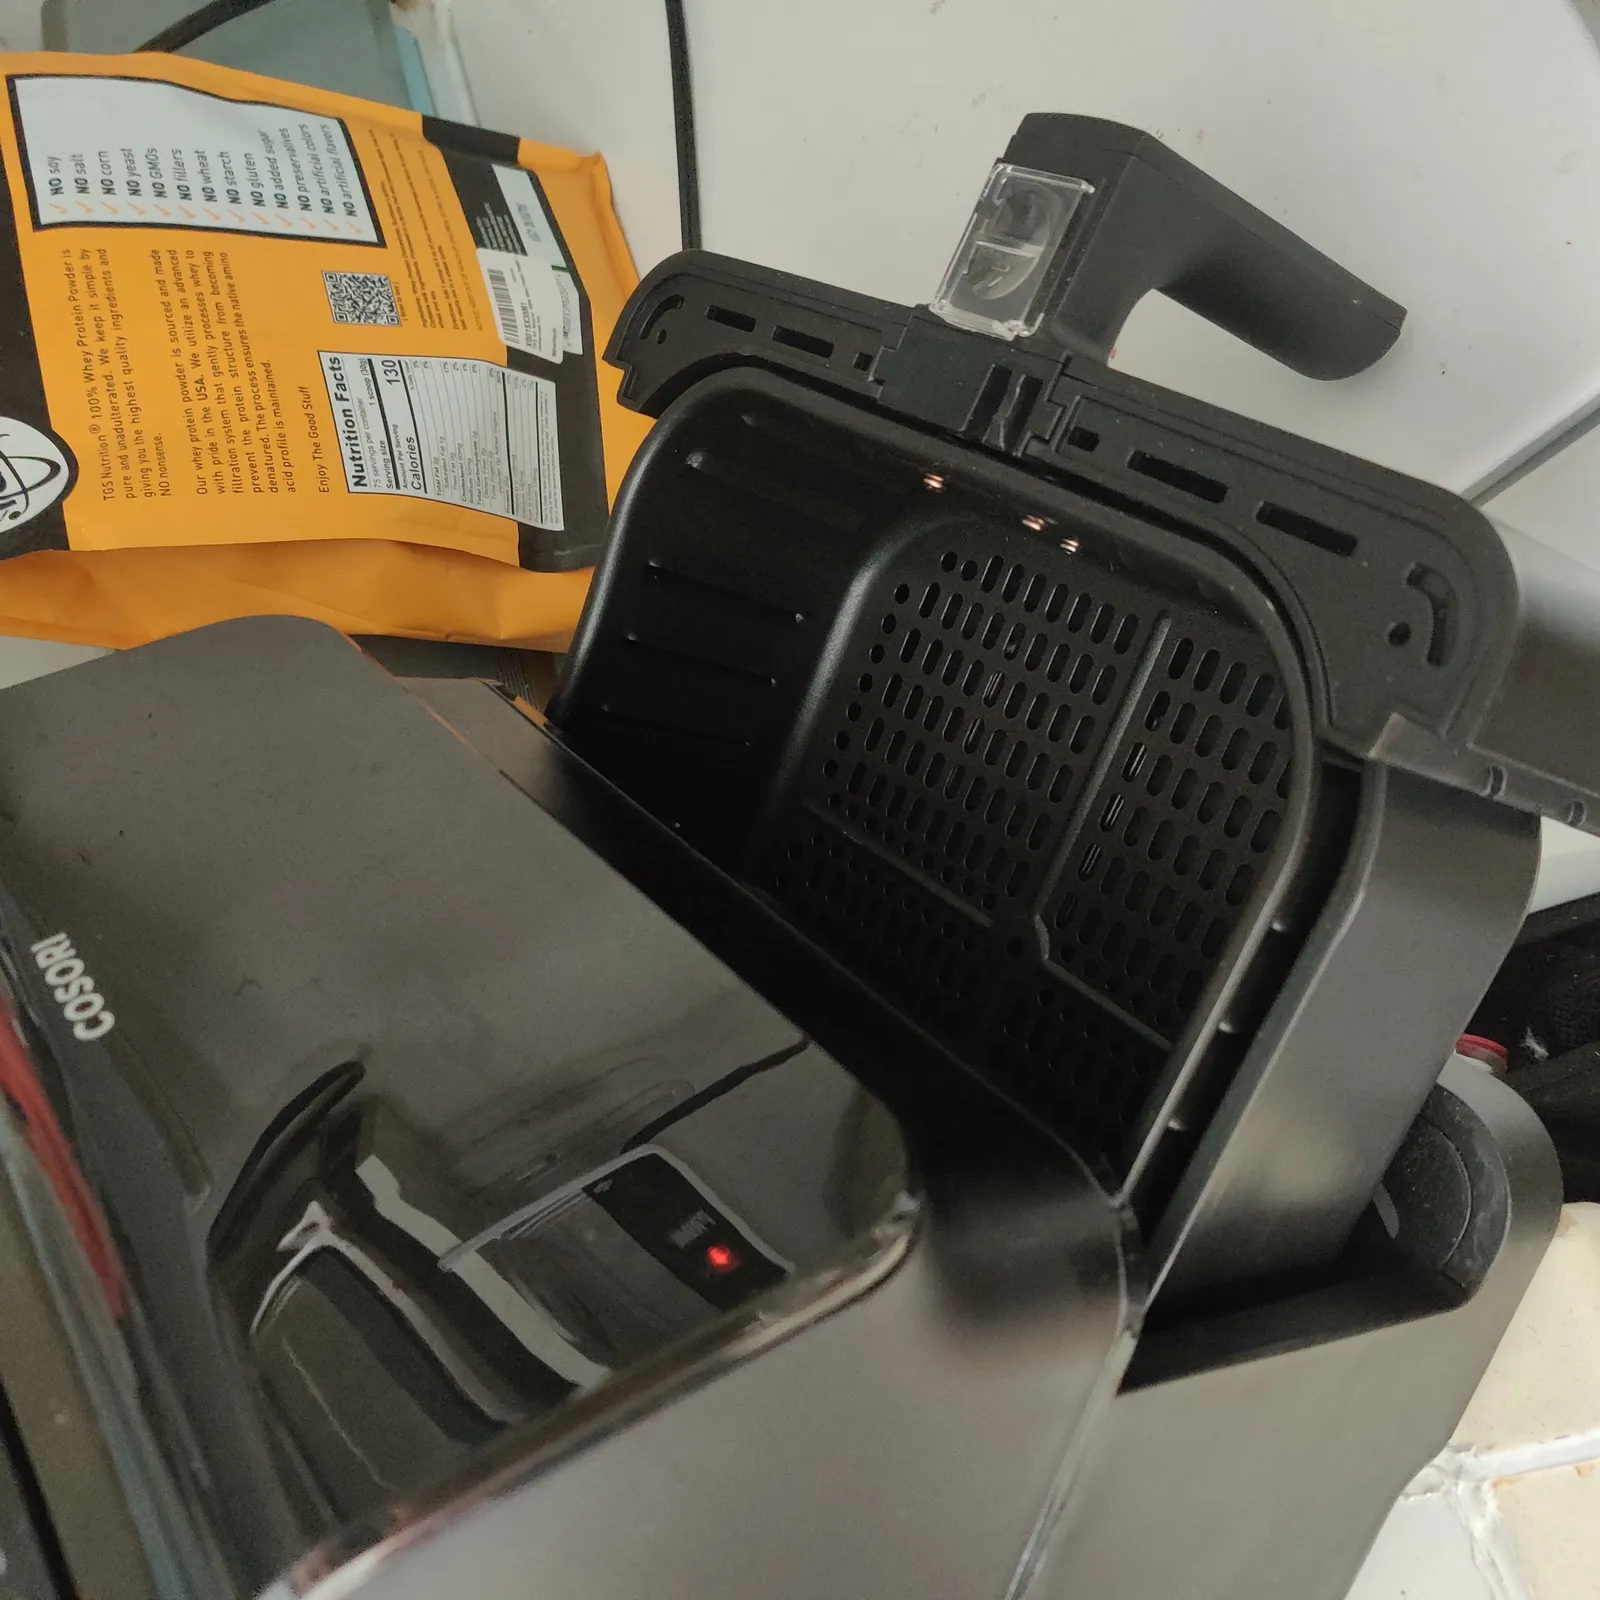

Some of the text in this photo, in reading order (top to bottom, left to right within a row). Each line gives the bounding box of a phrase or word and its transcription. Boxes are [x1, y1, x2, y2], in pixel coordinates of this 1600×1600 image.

[47, 157, 64, 196] NO soy
[71, 154, 90, 194] NO salt
[98, 151, 116, 195] NO corn
[120, 148, 142, 197] NO yeast
[145, 147, 167, 198] NO GMOs
[171, 149, 192, 201] NO fillers
[194, 150, 217, 202] NO wheat
[218, 152, 242, 204] NO starch
[244, 153, 266, 207] NO gluten
[258, 129, 289, 209] NO added sugar
[279, 128, 312, 211] NO preservatives
[298, 124, 335, 214] NO artificial colors
[320, 124, 357, 217] NO artificial flavors
[61, 249, 72, 258] is
[79, 249, 91, 260] by
[64, 262, 79, 301] Powder
[81, 265, 98, 298] simple
[73, 305, 88, 346] Protein
[93, 316, 106, 341] keep
[81, 351, 95, 383] Whey
[97, 249, 156, 498] giving you the highest quality ingredients and
[98, 349, 110, 365] We
[151, 249, 208, 494] Our whey protein powder is sourced and made
[167, 250, 225, 494] with pride in the USA. We utilize an advanced
[186, 250, 244, 494] filtration system that gently processes whey to
[203, 252, 263, 493] prevent the protein structure from becoming
[219, 252, 279, 493] denatured. The process ensures the native amino
[86, 387, 102, 419] 100%
[104, 371, 126, 450] unadulterated.
[261, 361, 282, 417] maintained.
[364, 378, 375, 399] scoop
[298, 385, 329, 492] Enjoy The Good Stuff
[328, 357, 367, 487] Nutrition Facts
[356, 397, 381, 488] 75 servings per container
[381, 360, 421, 490] Calories 130
[391, 424, 402, 448] Serving
[117, 455, 130, 470] and
[153, 433, 171, 496] NO nonsense.
[277, 433, 294, 467] profile
[382, 458, 394, 489] Serving
[101, 481, 115, 500] TGS
[121, 476, 137, 498] pure
[285, 471, 296, 492] acid
[399, 463, 408, 489] Amount
[30, 931, 115, 1041] COSORI
